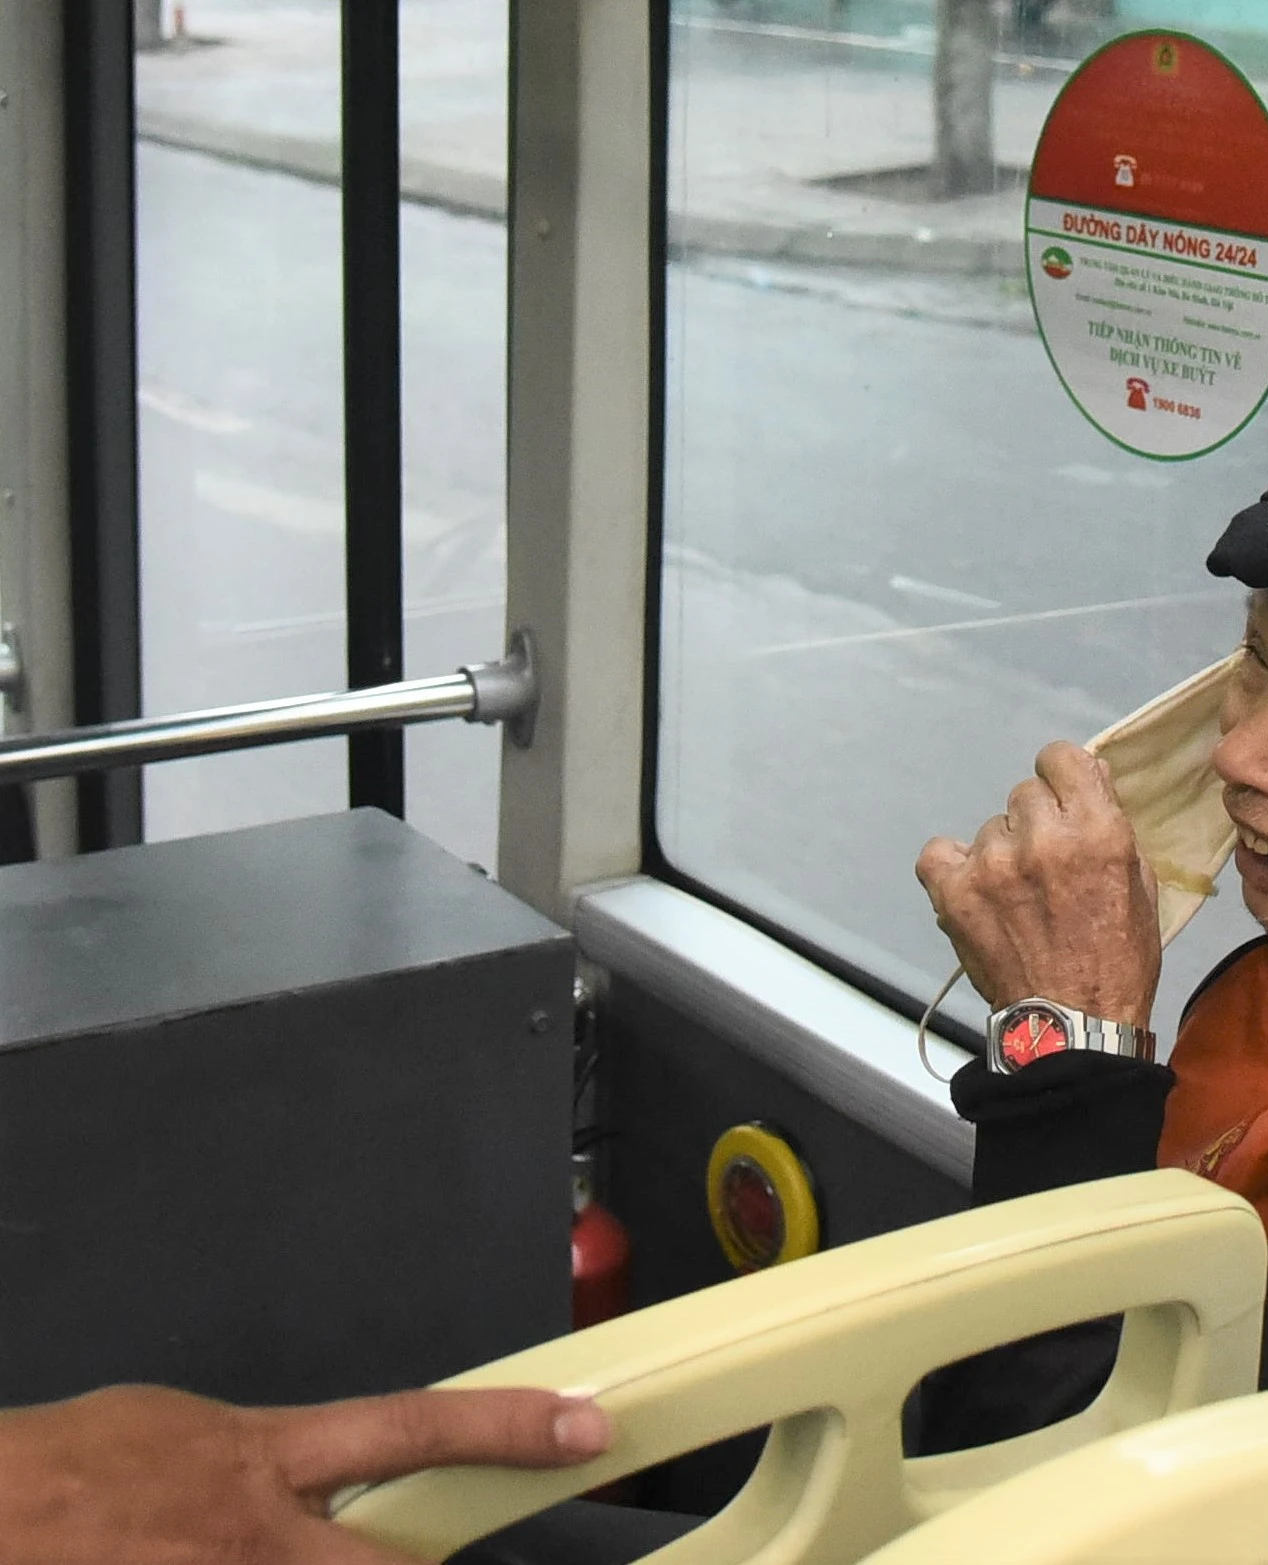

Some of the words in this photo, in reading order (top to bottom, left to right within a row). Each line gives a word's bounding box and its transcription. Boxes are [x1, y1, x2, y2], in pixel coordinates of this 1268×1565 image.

[1063, 212, 1122, 241] ĐƯỜNG
[1126, 222, 1159, 248] DÂY
[1163, 229, 1210, 259] NÓNG
[1215, 242, 1257, 268] 24/24
[1088, 320, 1114, 338] TIẾP
[1116, 324, 1150, 349] NHẬN
[1153, 335, 1197, 360] THÔNG
[1200, 346, 1221, 365] TIN
[1110, 346, 1140, 368] DỊCH
[1143, 354, 1160, 375] VỤ
[1161, 359, 1179, 377] XE
[1182, 363, 1216, 386] BUÝT
